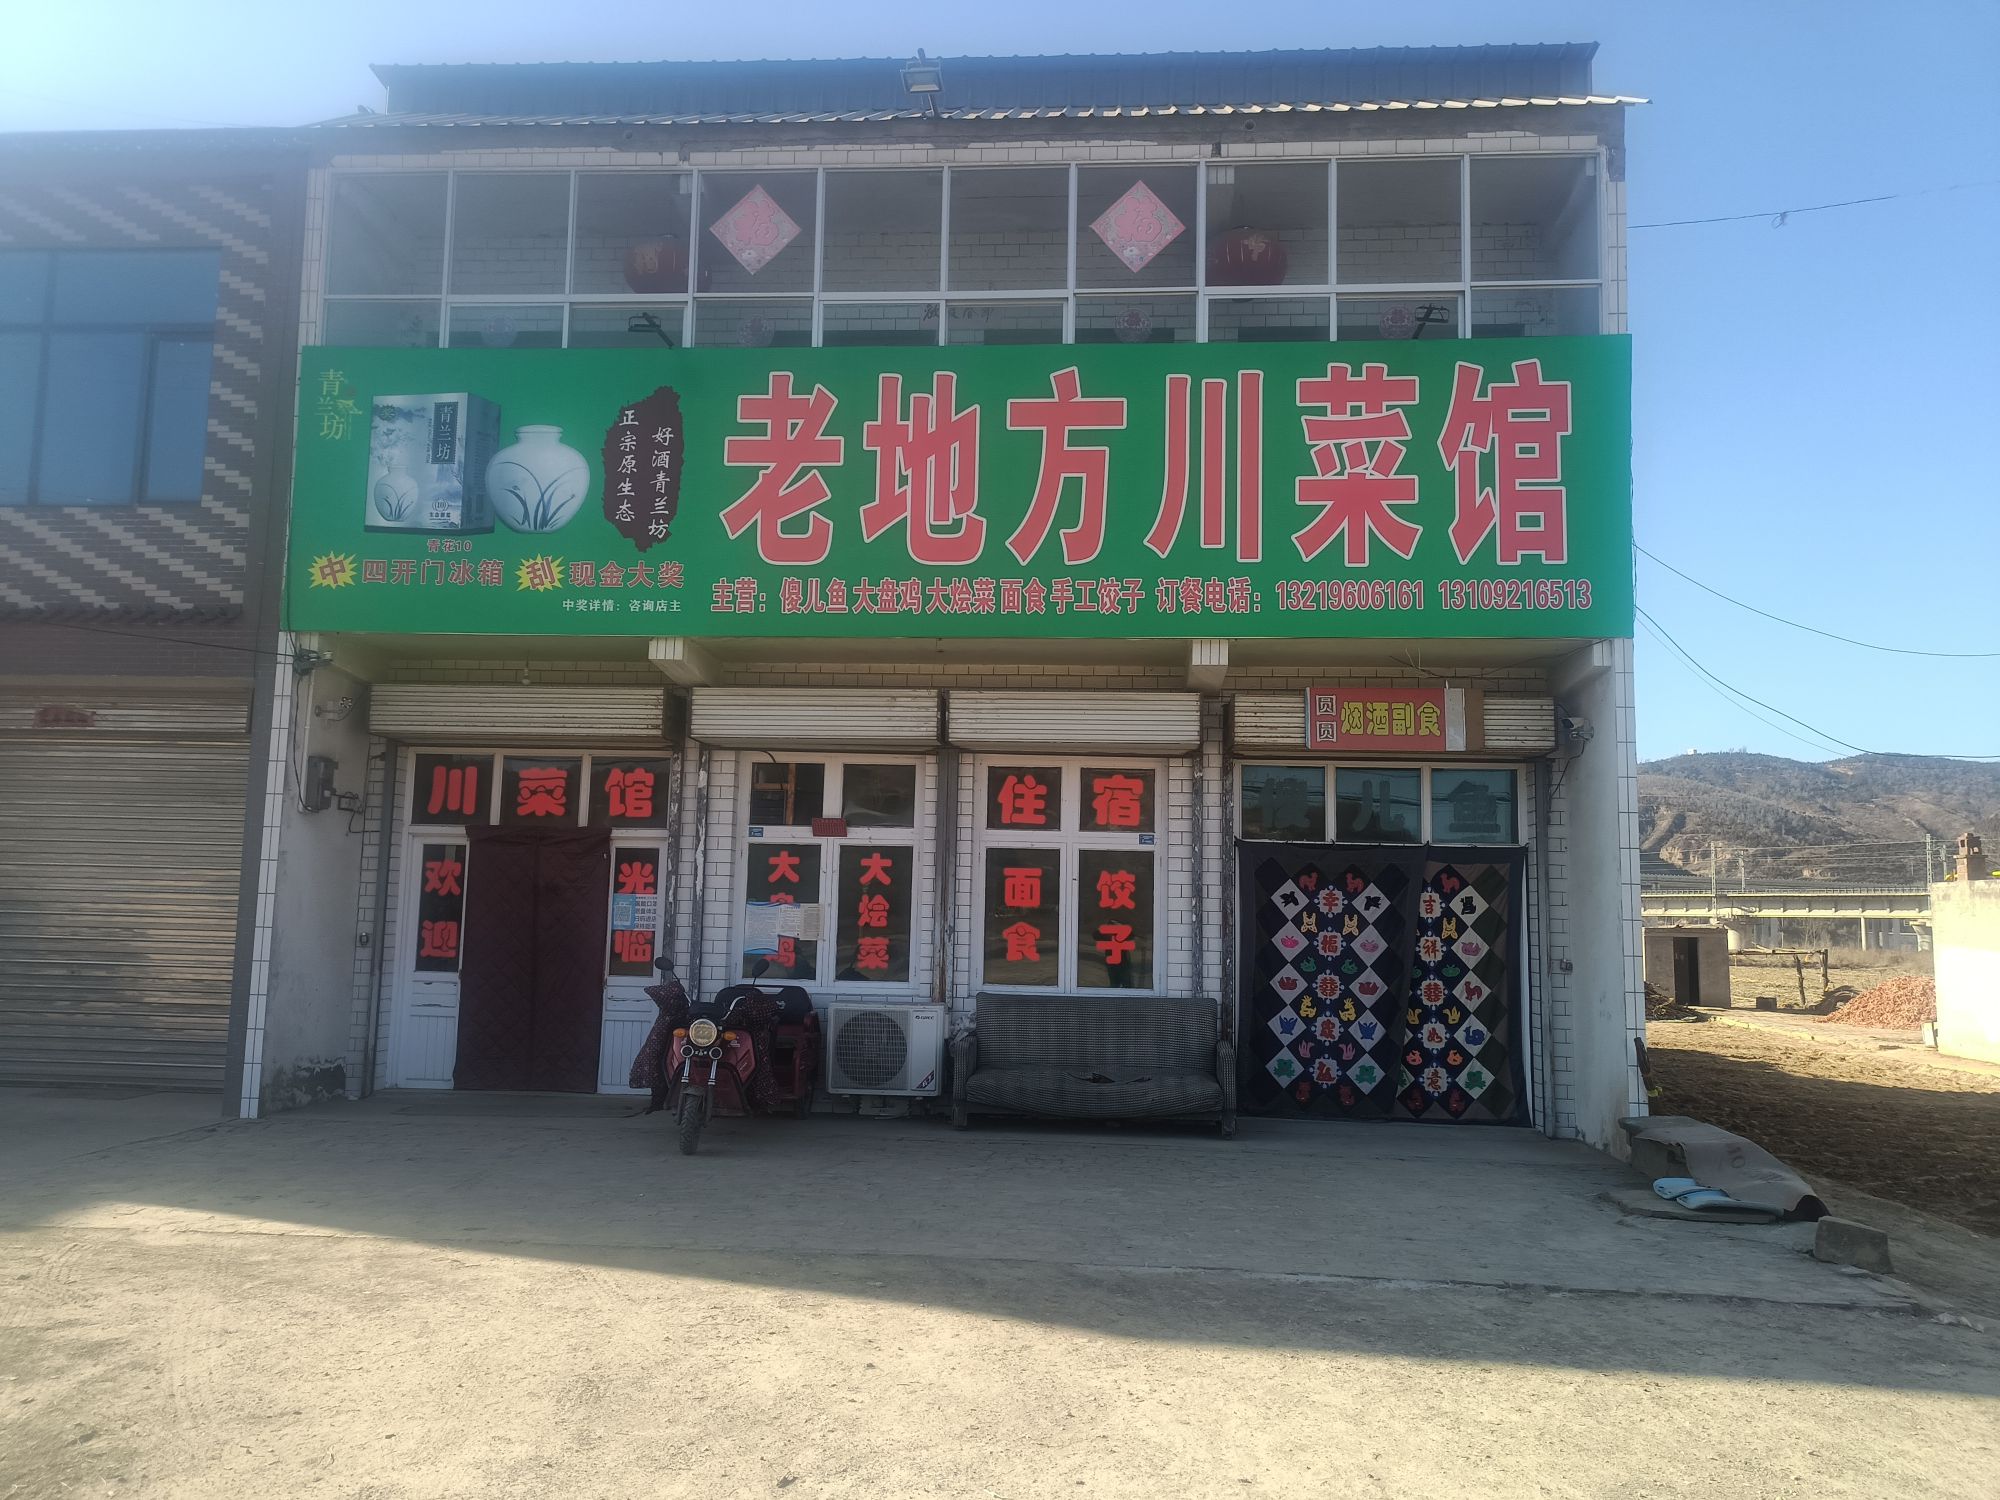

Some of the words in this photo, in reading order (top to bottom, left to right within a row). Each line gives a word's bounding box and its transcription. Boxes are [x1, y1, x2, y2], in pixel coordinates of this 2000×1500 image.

[1115, 198, 1162, 242] 福
[436, 404, 455, 460] 青兰坊
[616, 409, 639, 522] 正宗原生态
[648, 426, 674, 539] 好酒青兰坊
[719, 358, 1572, 566] 老地方川菜馆
[319, 557, 346, 585] 中
[361, 558, 504, 586] 四开门冰箱
[525, 556, 557, 590] 刮
[569, 560, 684, 588] 现金大奖
[427, 538, 472, 552] 青花10
[629, 599, 681, 612] 咨询店主
[780, 577, 848, 614] 傻儿鱼
[852, 577, 922, 614] 大盘鸡
[925, 577, 996, 614] 大烩菜
[1000, 578, 1046, 613] 面食
[1050, 577, 1146, 614] 手工饺子
[1275, 580, 1424, 610] 13219606161
[1438, 579, 1593, 610] 13109216513
[1316, 695, 1337, 742] 圆圆
[1341, 701, 1441, 737] 烟酒副食
[427, 766, 655, 817] 川菜馆
[998, 775, 1143, 827] 住宿
[420, 860, 462, 957] 欢迎
[614, 861, 655, 962] 光临
[763, 851, 800, 968] 大鸡
[857, 853, 892, 969] 大烩菜
[1003, 867, 1042, 962] 面食
[1096, 870, 1135, 965] 饺子
